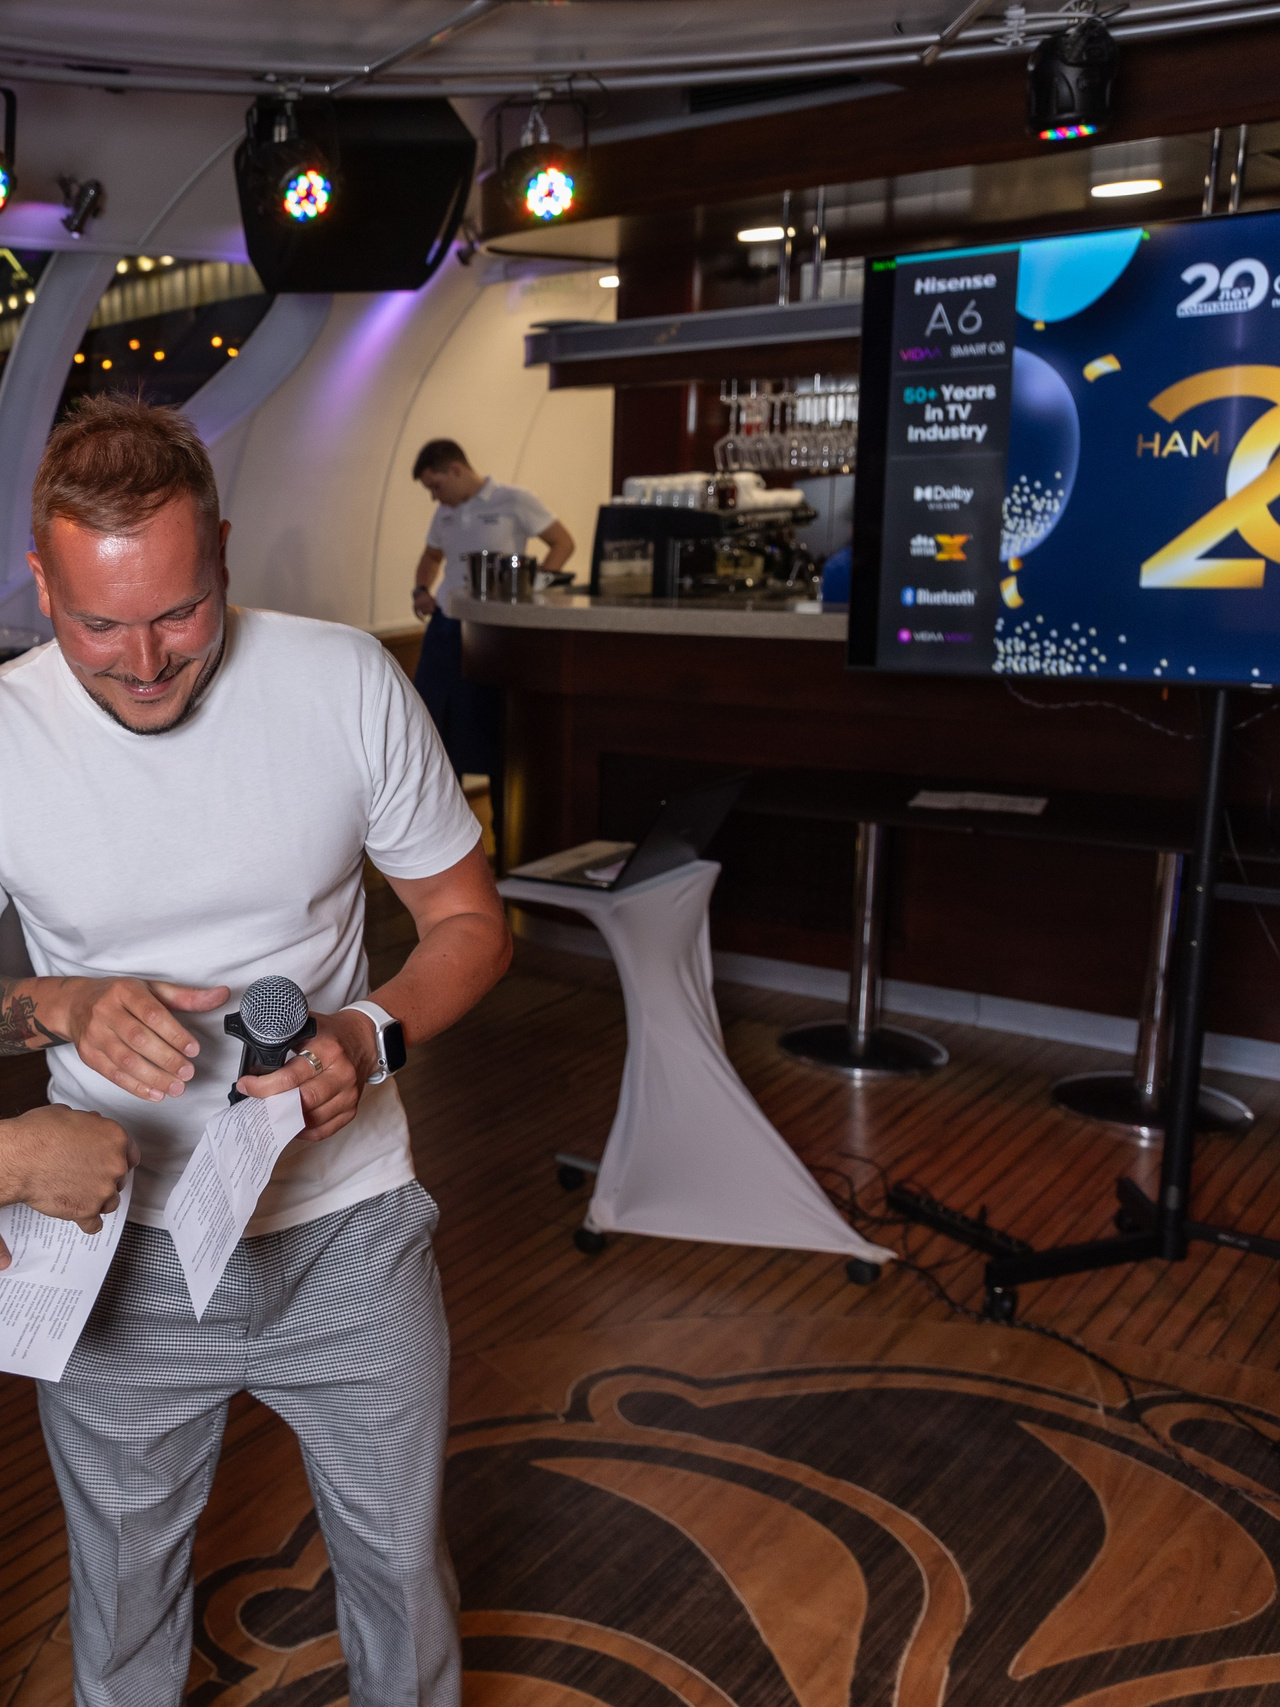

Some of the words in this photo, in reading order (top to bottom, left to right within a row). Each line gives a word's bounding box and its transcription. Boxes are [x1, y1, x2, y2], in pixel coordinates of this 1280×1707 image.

[914, 273, 997, 296] Hisense
[1176, 257, 1269, 318] 20
[1218, 286, 1251, 301] лет
[924, 299, 982, 337] A6
[950, 342, 986, 359] SMART
[940, 383, 997, 402] Years
[945, 402, 972, 421] TV
[907, 423, 988, 443] Industry
[933, 484, 974, 504] Dolby
[916, 588, 975, 606] Bluetooth
